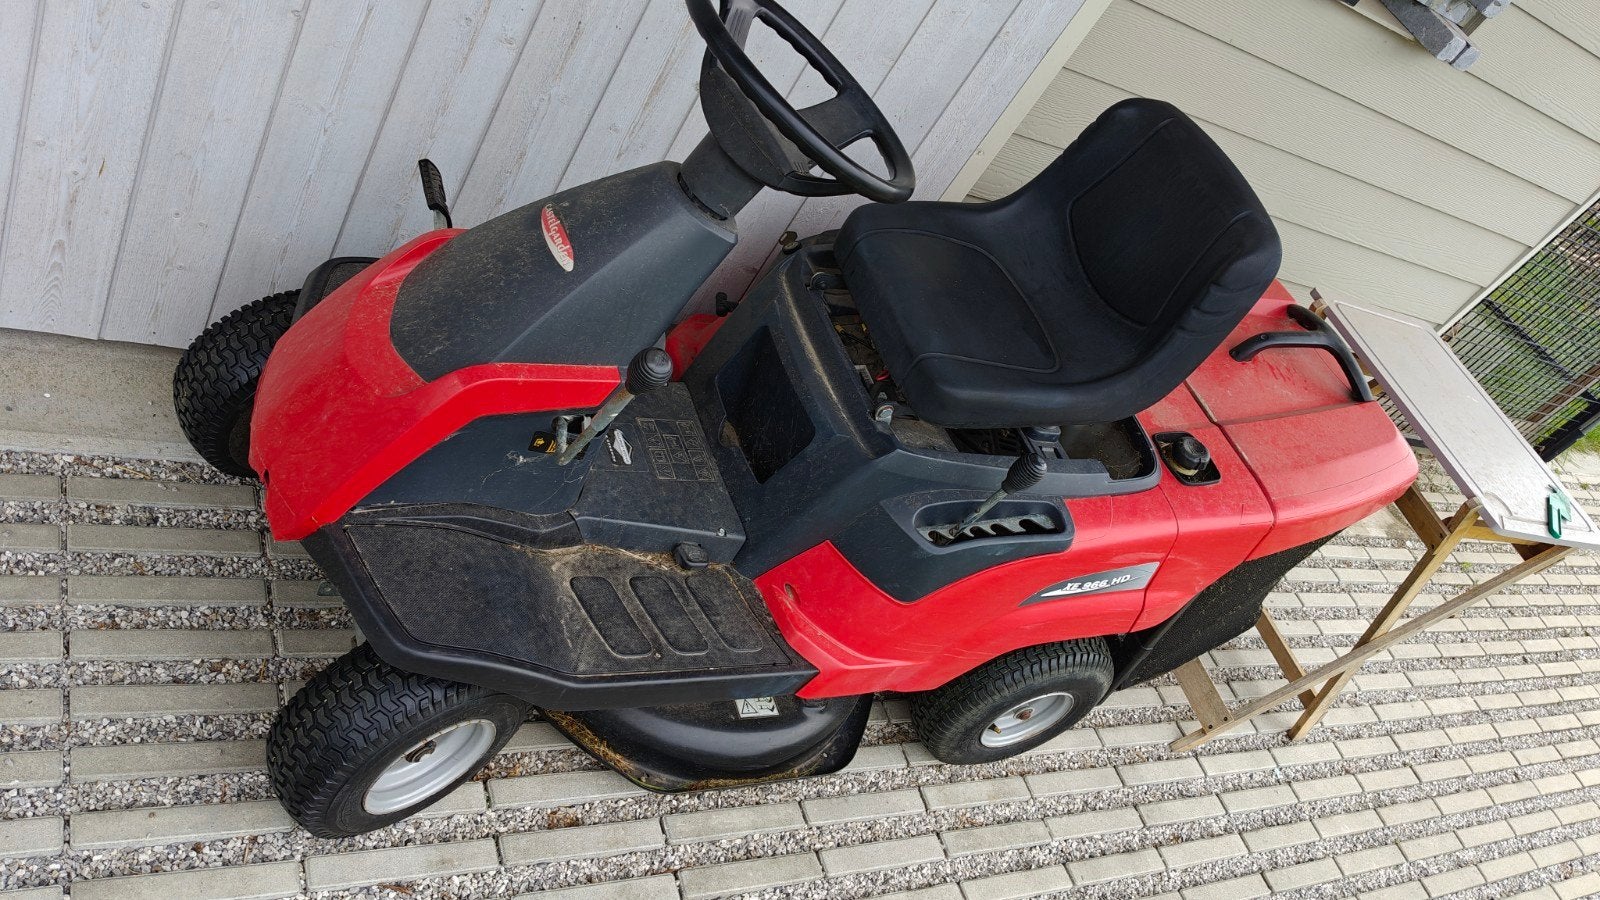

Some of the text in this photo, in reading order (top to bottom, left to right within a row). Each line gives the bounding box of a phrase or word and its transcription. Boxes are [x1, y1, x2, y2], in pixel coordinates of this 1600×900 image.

[1063, 574, 1131, 591] XE 966 HD
